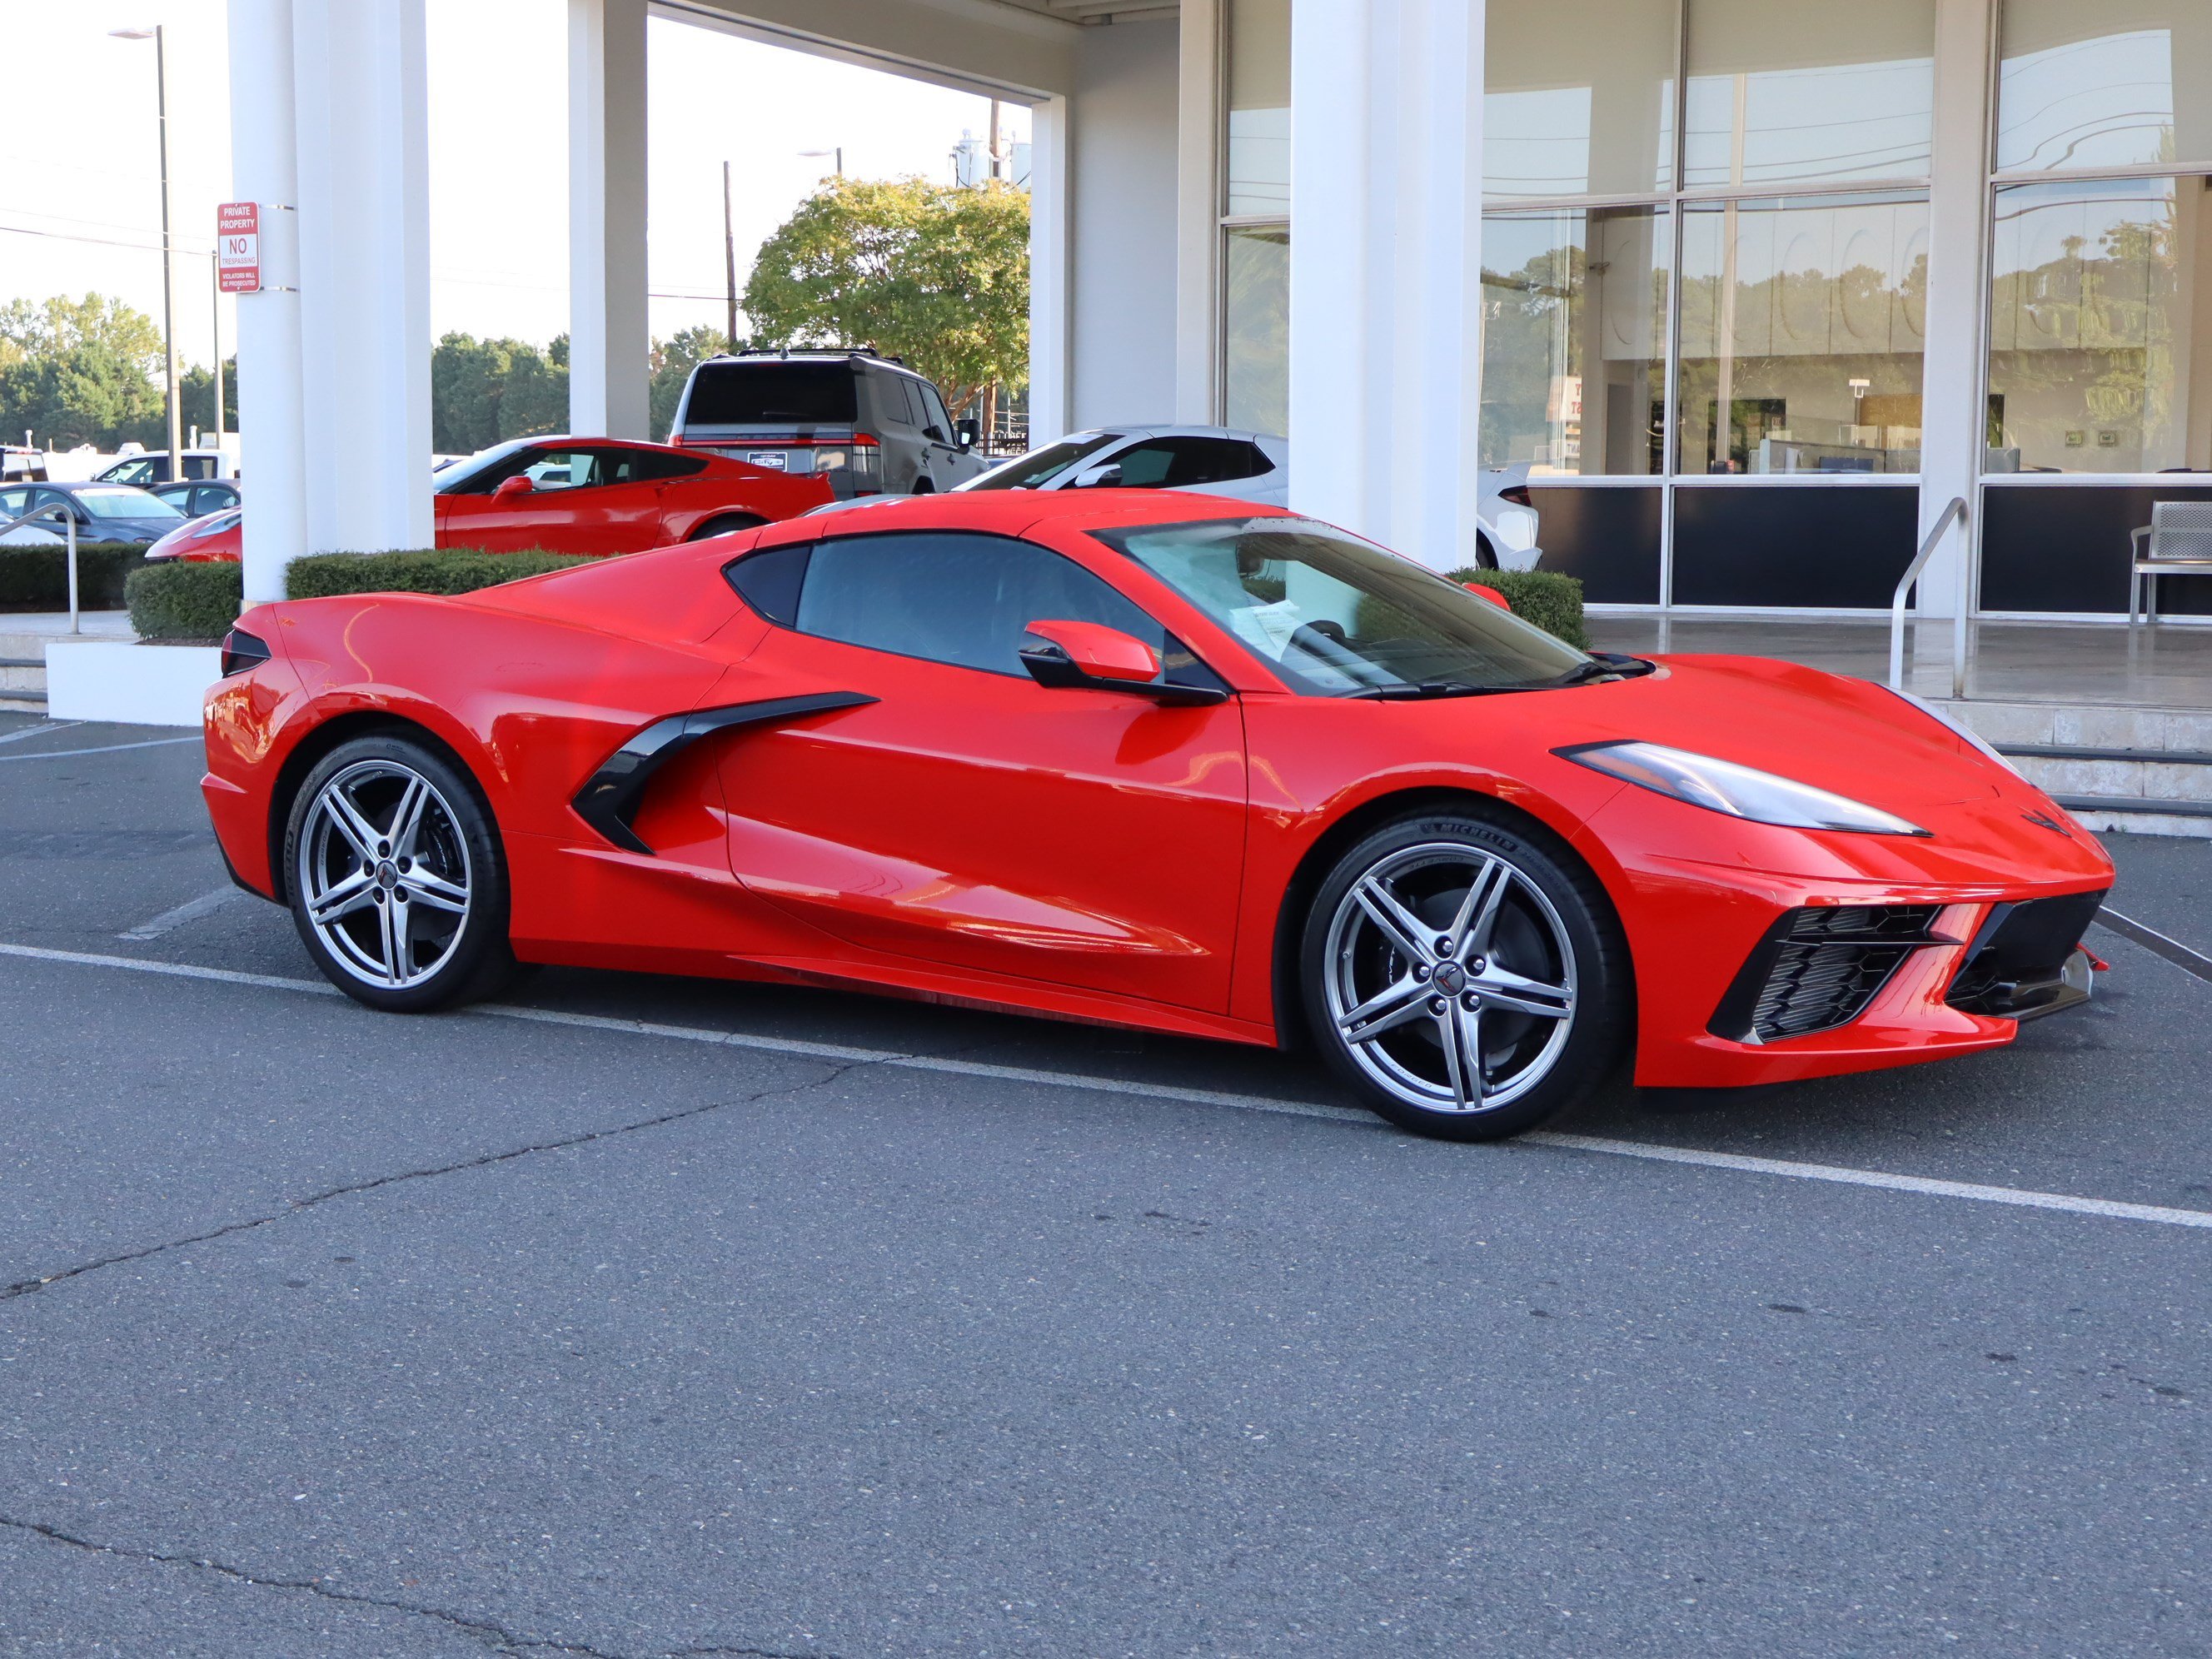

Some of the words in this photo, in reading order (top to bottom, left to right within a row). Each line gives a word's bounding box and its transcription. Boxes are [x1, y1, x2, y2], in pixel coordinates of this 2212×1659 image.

[224, 207, 251, 217] PRIVATE
[220, 219, 255, 229] PROPERTY
[229, 238, 247, 254] NO
[222, 257, 256, 265] TRESPASSING
[1440, 824, 1514, 849] MICHELIN
[1390, 1064, 1433, 1089] FORGED
